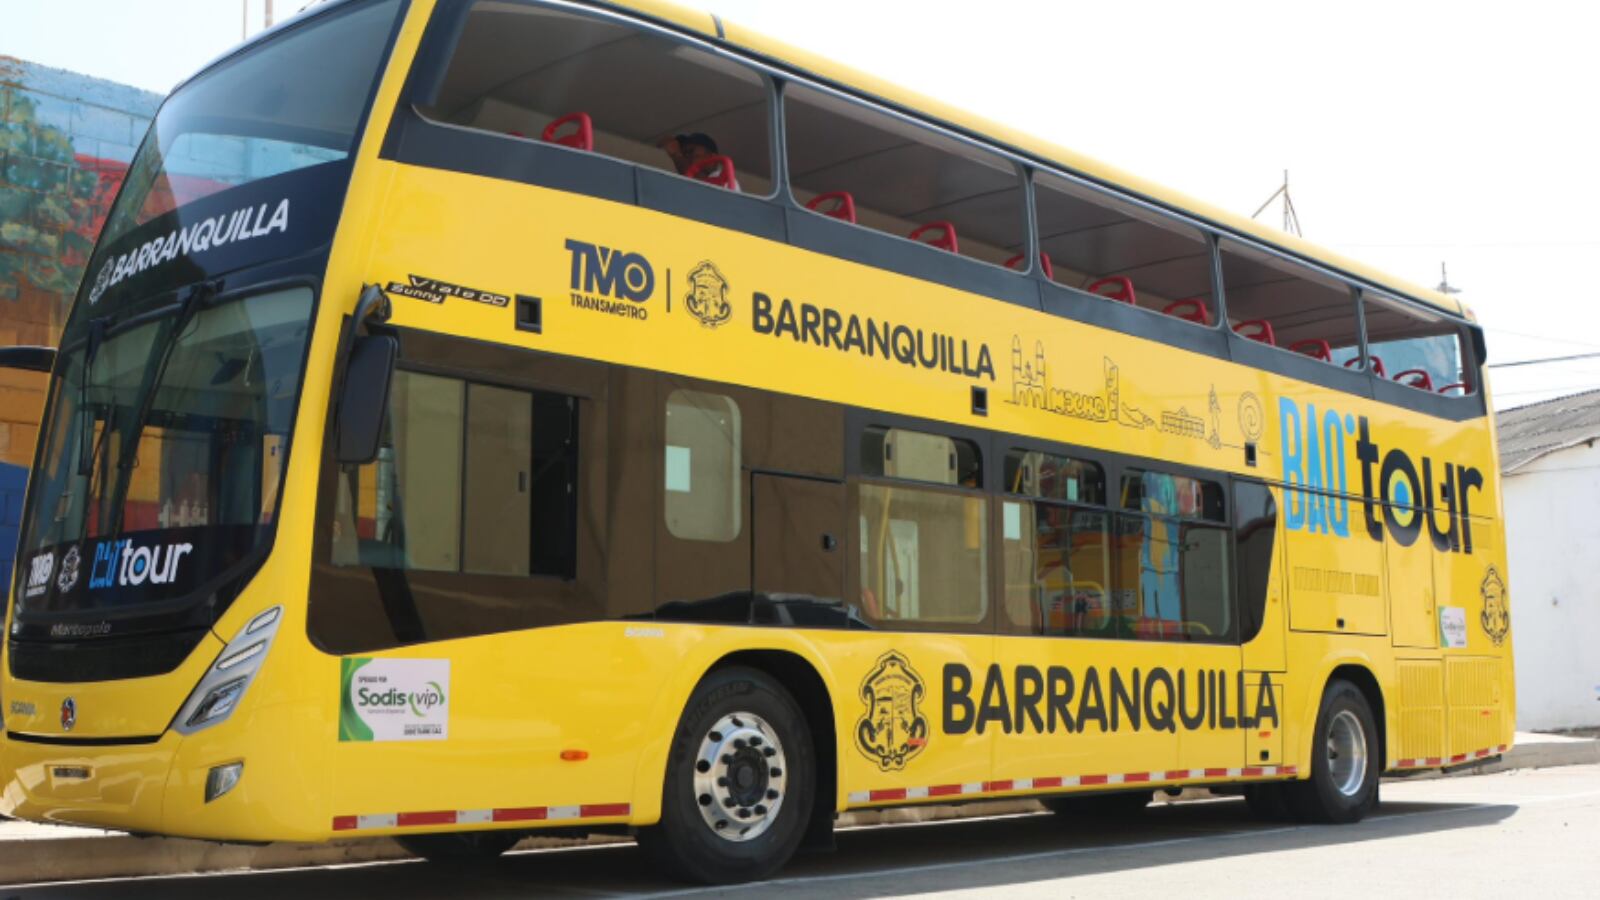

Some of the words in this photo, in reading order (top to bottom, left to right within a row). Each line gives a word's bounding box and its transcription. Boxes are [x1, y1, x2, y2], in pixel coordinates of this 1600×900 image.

[109, 198, 289, 286] BARRANQUILLA
[565, 238, 655, 303] TMO
[391, 284, 442, 303] Sunny
[411, 277, 475, 298] Viale
[752, 292, 996, 381] BARRANQUILLA
[1356, 415, 1483, 555] tour
[119, 539, 193, 586] tour
[358, 687, 406, 707] Sodis
[415, 689, 438, 709] vip
[942, 663, 1278, 734] BARRANQUILLA
